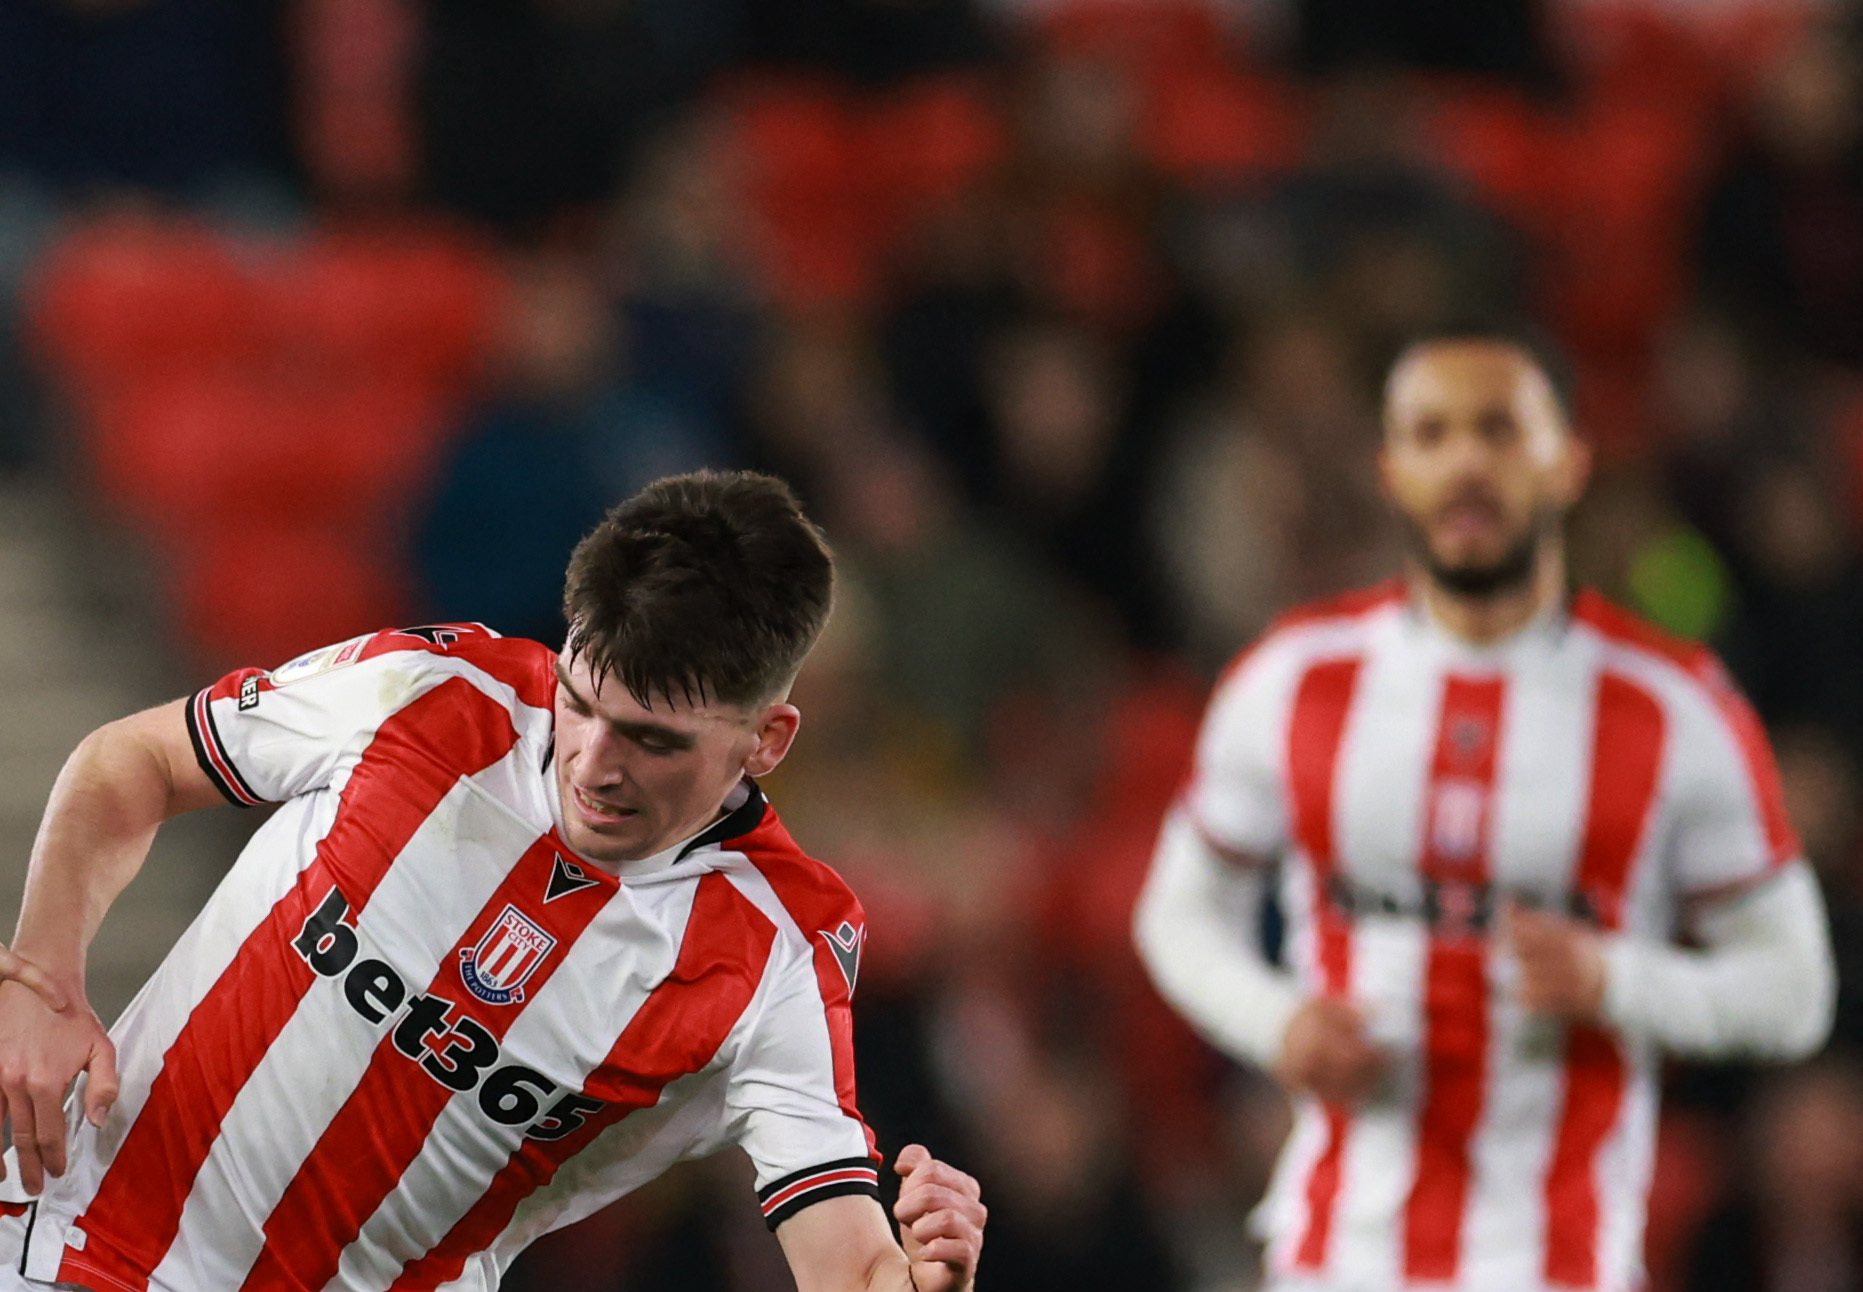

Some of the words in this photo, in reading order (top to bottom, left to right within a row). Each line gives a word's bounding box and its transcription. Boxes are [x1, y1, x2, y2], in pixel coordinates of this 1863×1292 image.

[505, 914, 546, 952] STOKE
[508, 932, 530, 950] CITY
[480, 971, 498, 987] 1863
[290, 885, 609, 1141] bet365
